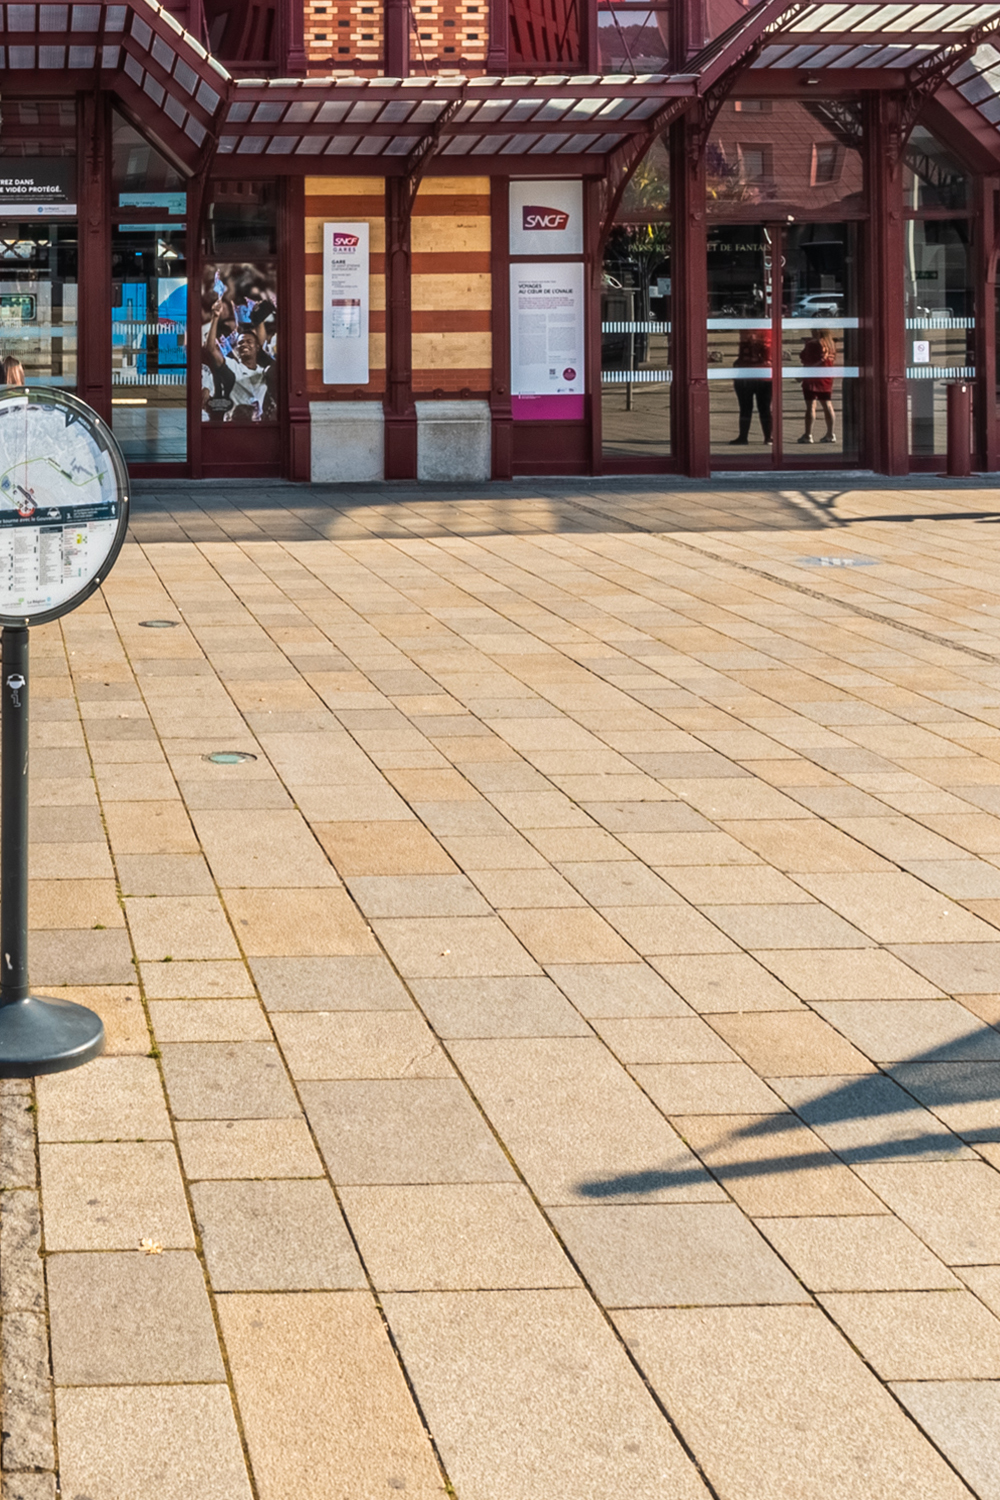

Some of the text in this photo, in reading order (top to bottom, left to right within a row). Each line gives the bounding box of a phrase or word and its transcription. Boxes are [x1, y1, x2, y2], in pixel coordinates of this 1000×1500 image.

[5, 185, 27, 193] VIDÉO
[28, 184, 62, 193] PROTÉGÉ.
[524, 214, 567, 228] SNCF
[334, 237, 358, 246] SNCF
[720, 243, 733, 252] DE
[735, 243, 772, 252] FANTAIS
